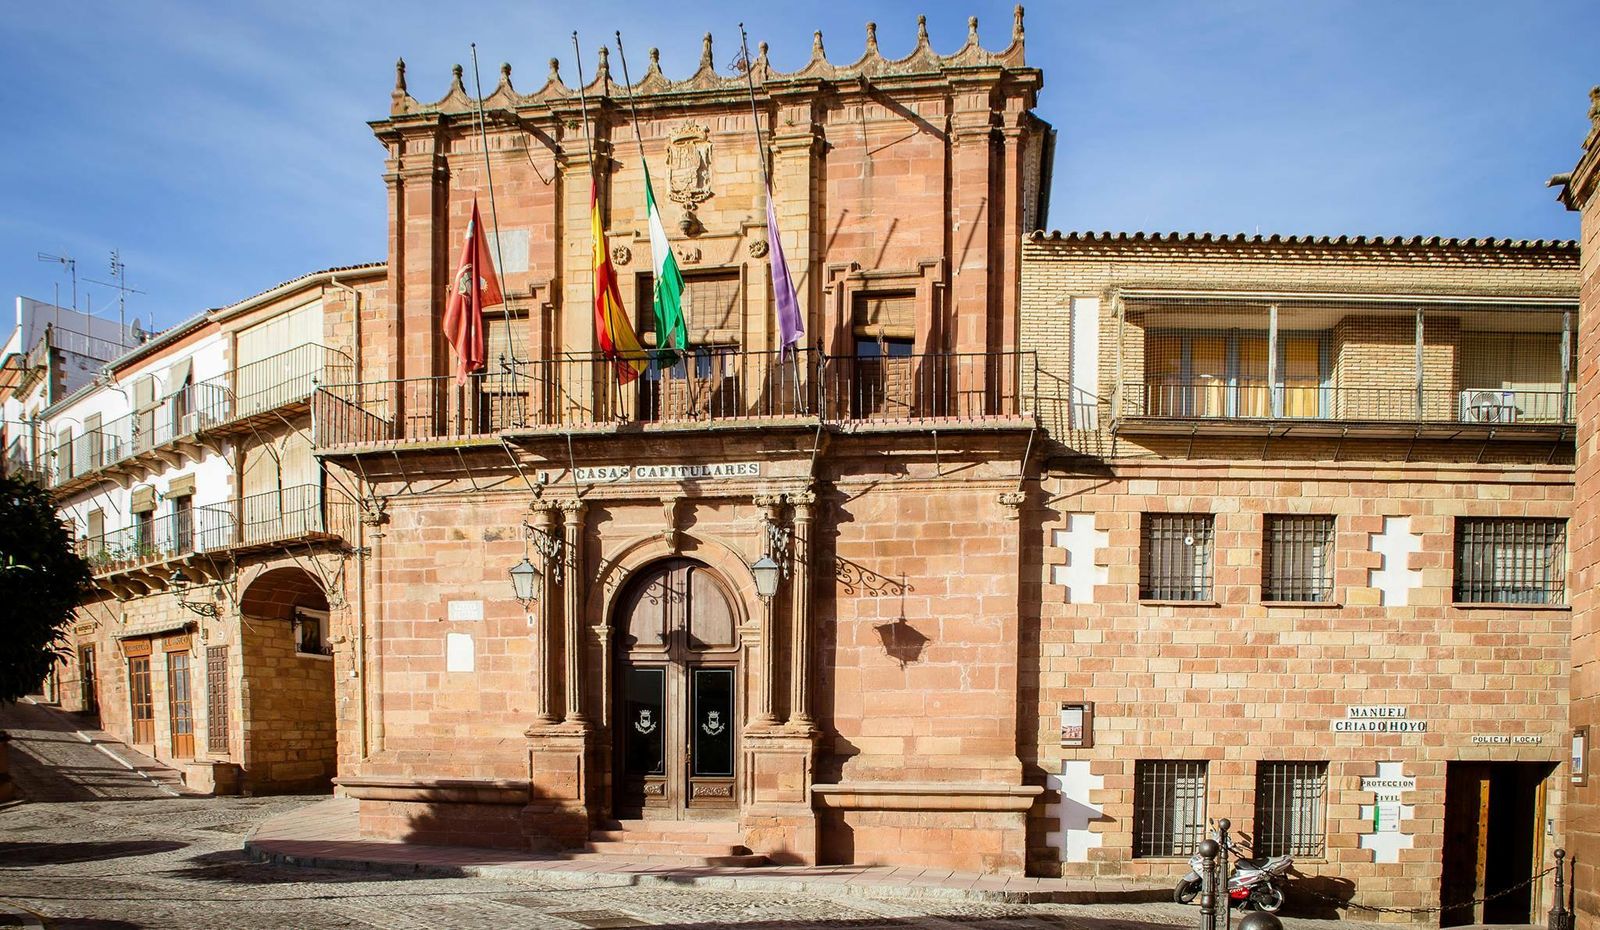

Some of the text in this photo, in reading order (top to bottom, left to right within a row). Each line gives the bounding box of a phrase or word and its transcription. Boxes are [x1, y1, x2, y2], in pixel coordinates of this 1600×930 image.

[576, 463, 759, 480] CASAS CAPITULARES
[1350, 707, 1405, 718] MANUEL
[1335, 721, 1426, 732] CRIADO HOYO
